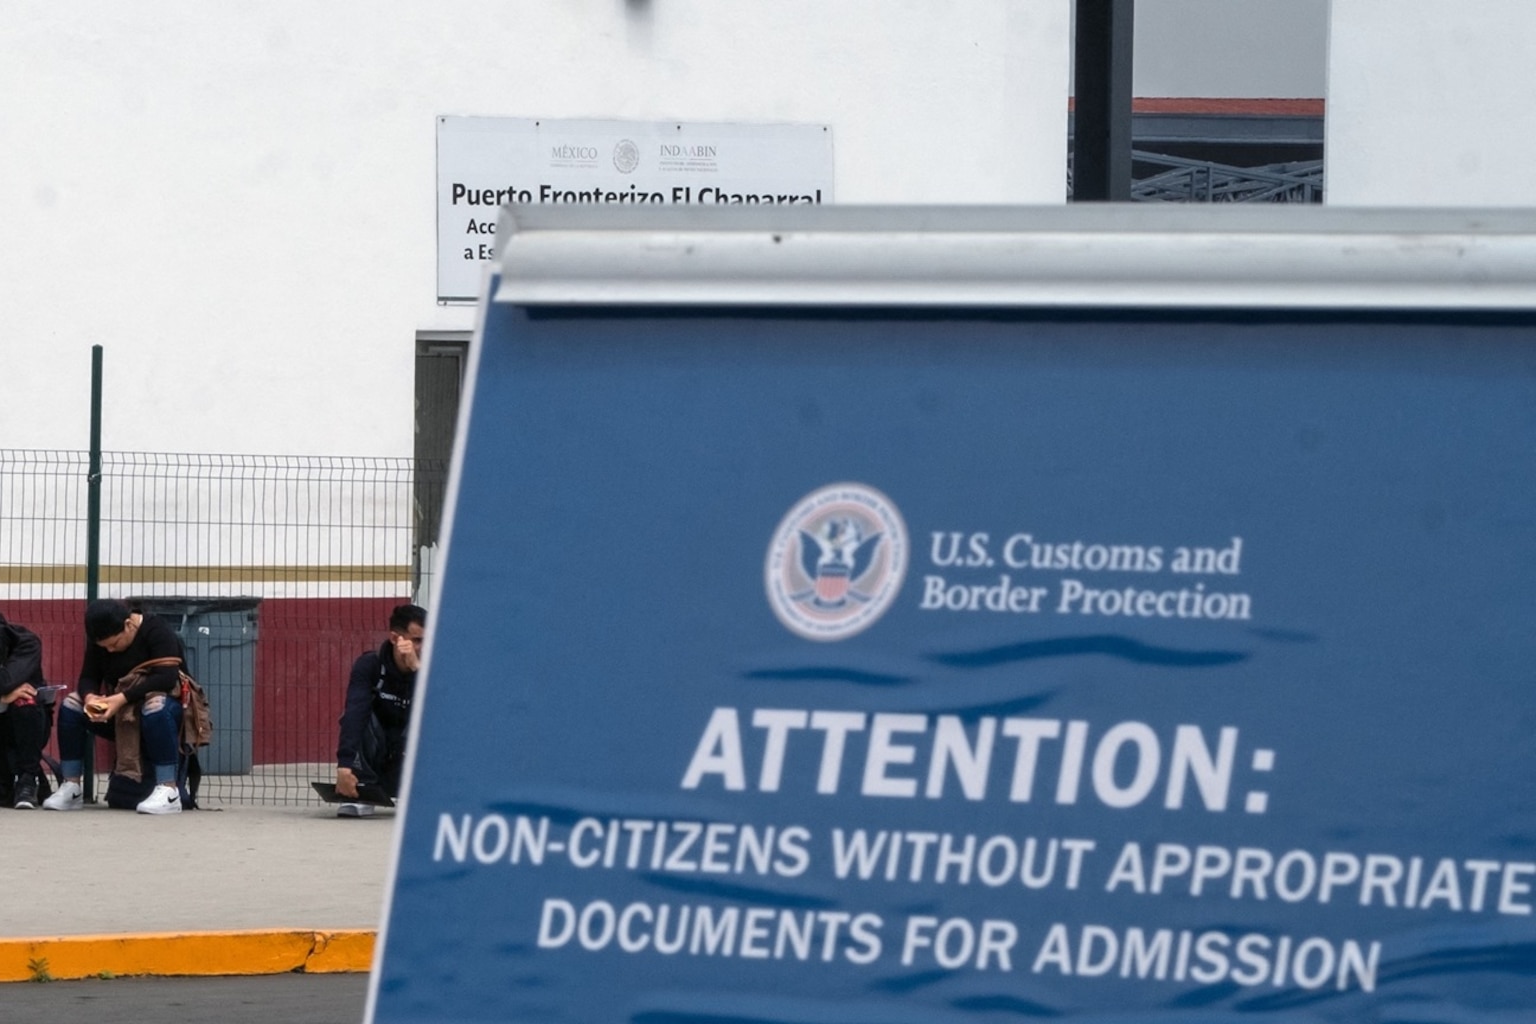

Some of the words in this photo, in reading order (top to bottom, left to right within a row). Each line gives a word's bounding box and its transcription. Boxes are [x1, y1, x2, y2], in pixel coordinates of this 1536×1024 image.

[552, 144, 598, 159] MÉXICO
[452, 183, 532, 206] Puerto
[930, 532, 995, 567] U.S.
[1003, 534, 1163, 573] Customs
[1171, 537, 1243, 575] and
[920, 576, 1047, 613] Border
[1057, 580, 1252, 620] Protection
[681, 707, 1275, 814] ATTENTION:
[433, 813, 812, 878] NON-CITIZENS
[832, 829, 1096, 890] WITHOUT
[1105, 841, 1536, 915] APPROPRIATE
[537, 899, 884, 966] DOCUMENTS
[901, 916, 1019, 971] FOR
[1033, 923, 1381, 993] ADMISSION
